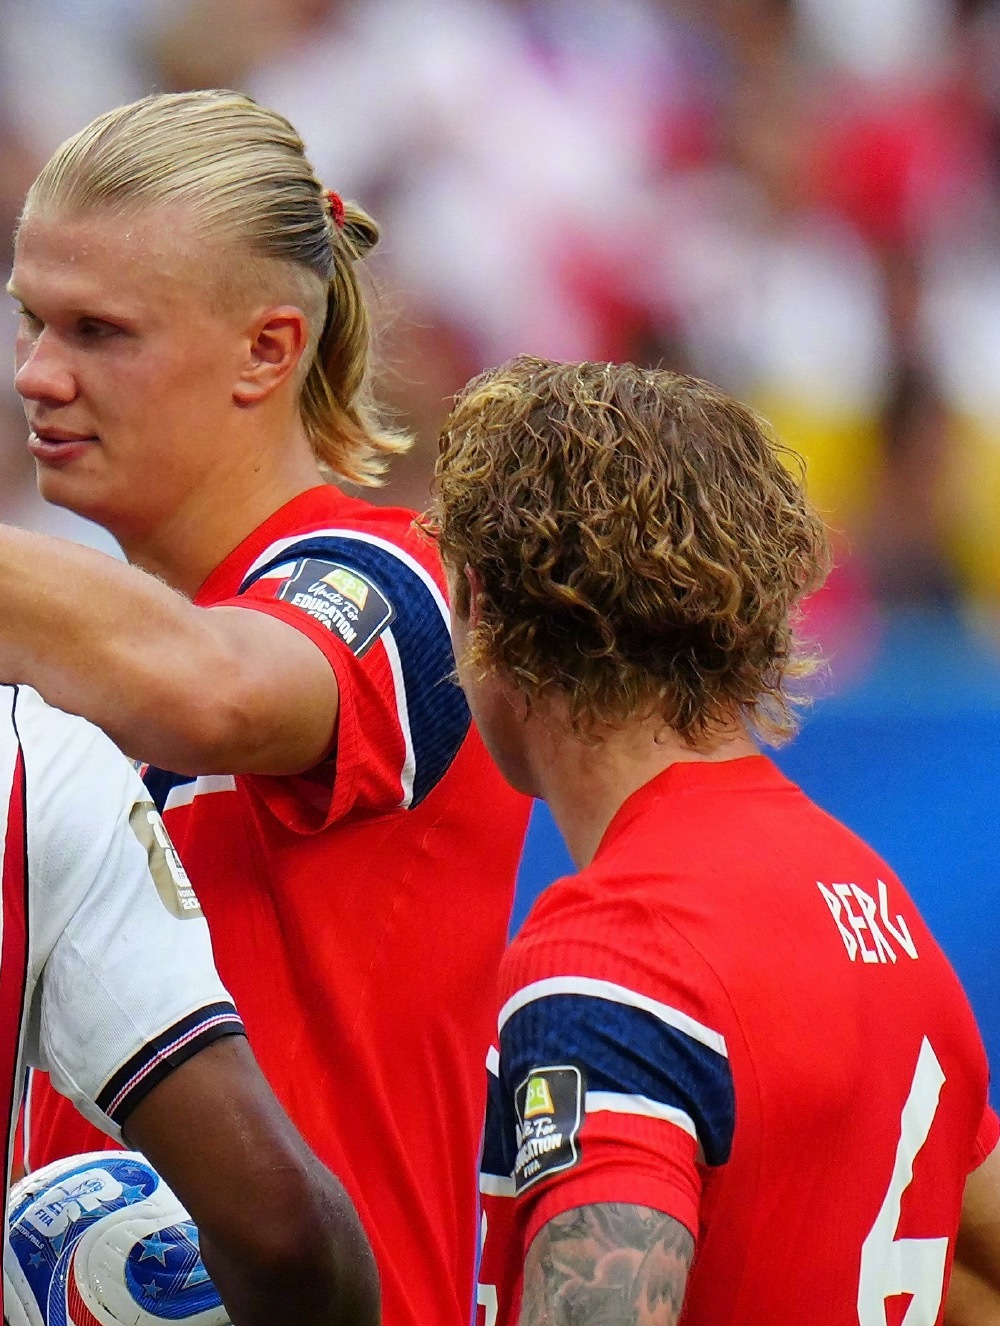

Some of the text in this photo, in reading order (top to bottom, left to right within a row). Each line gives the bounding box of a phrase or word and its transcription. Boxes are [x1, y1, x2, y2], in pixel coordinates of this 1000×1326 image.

[290, 592, 358, 645] EDUCATION
[342, 601, 359, 621] For
[816, 879, 919, 965] BERG
[533, 1117, 556, 1138] For
[35, 1208, 54, 1227] FIFA
